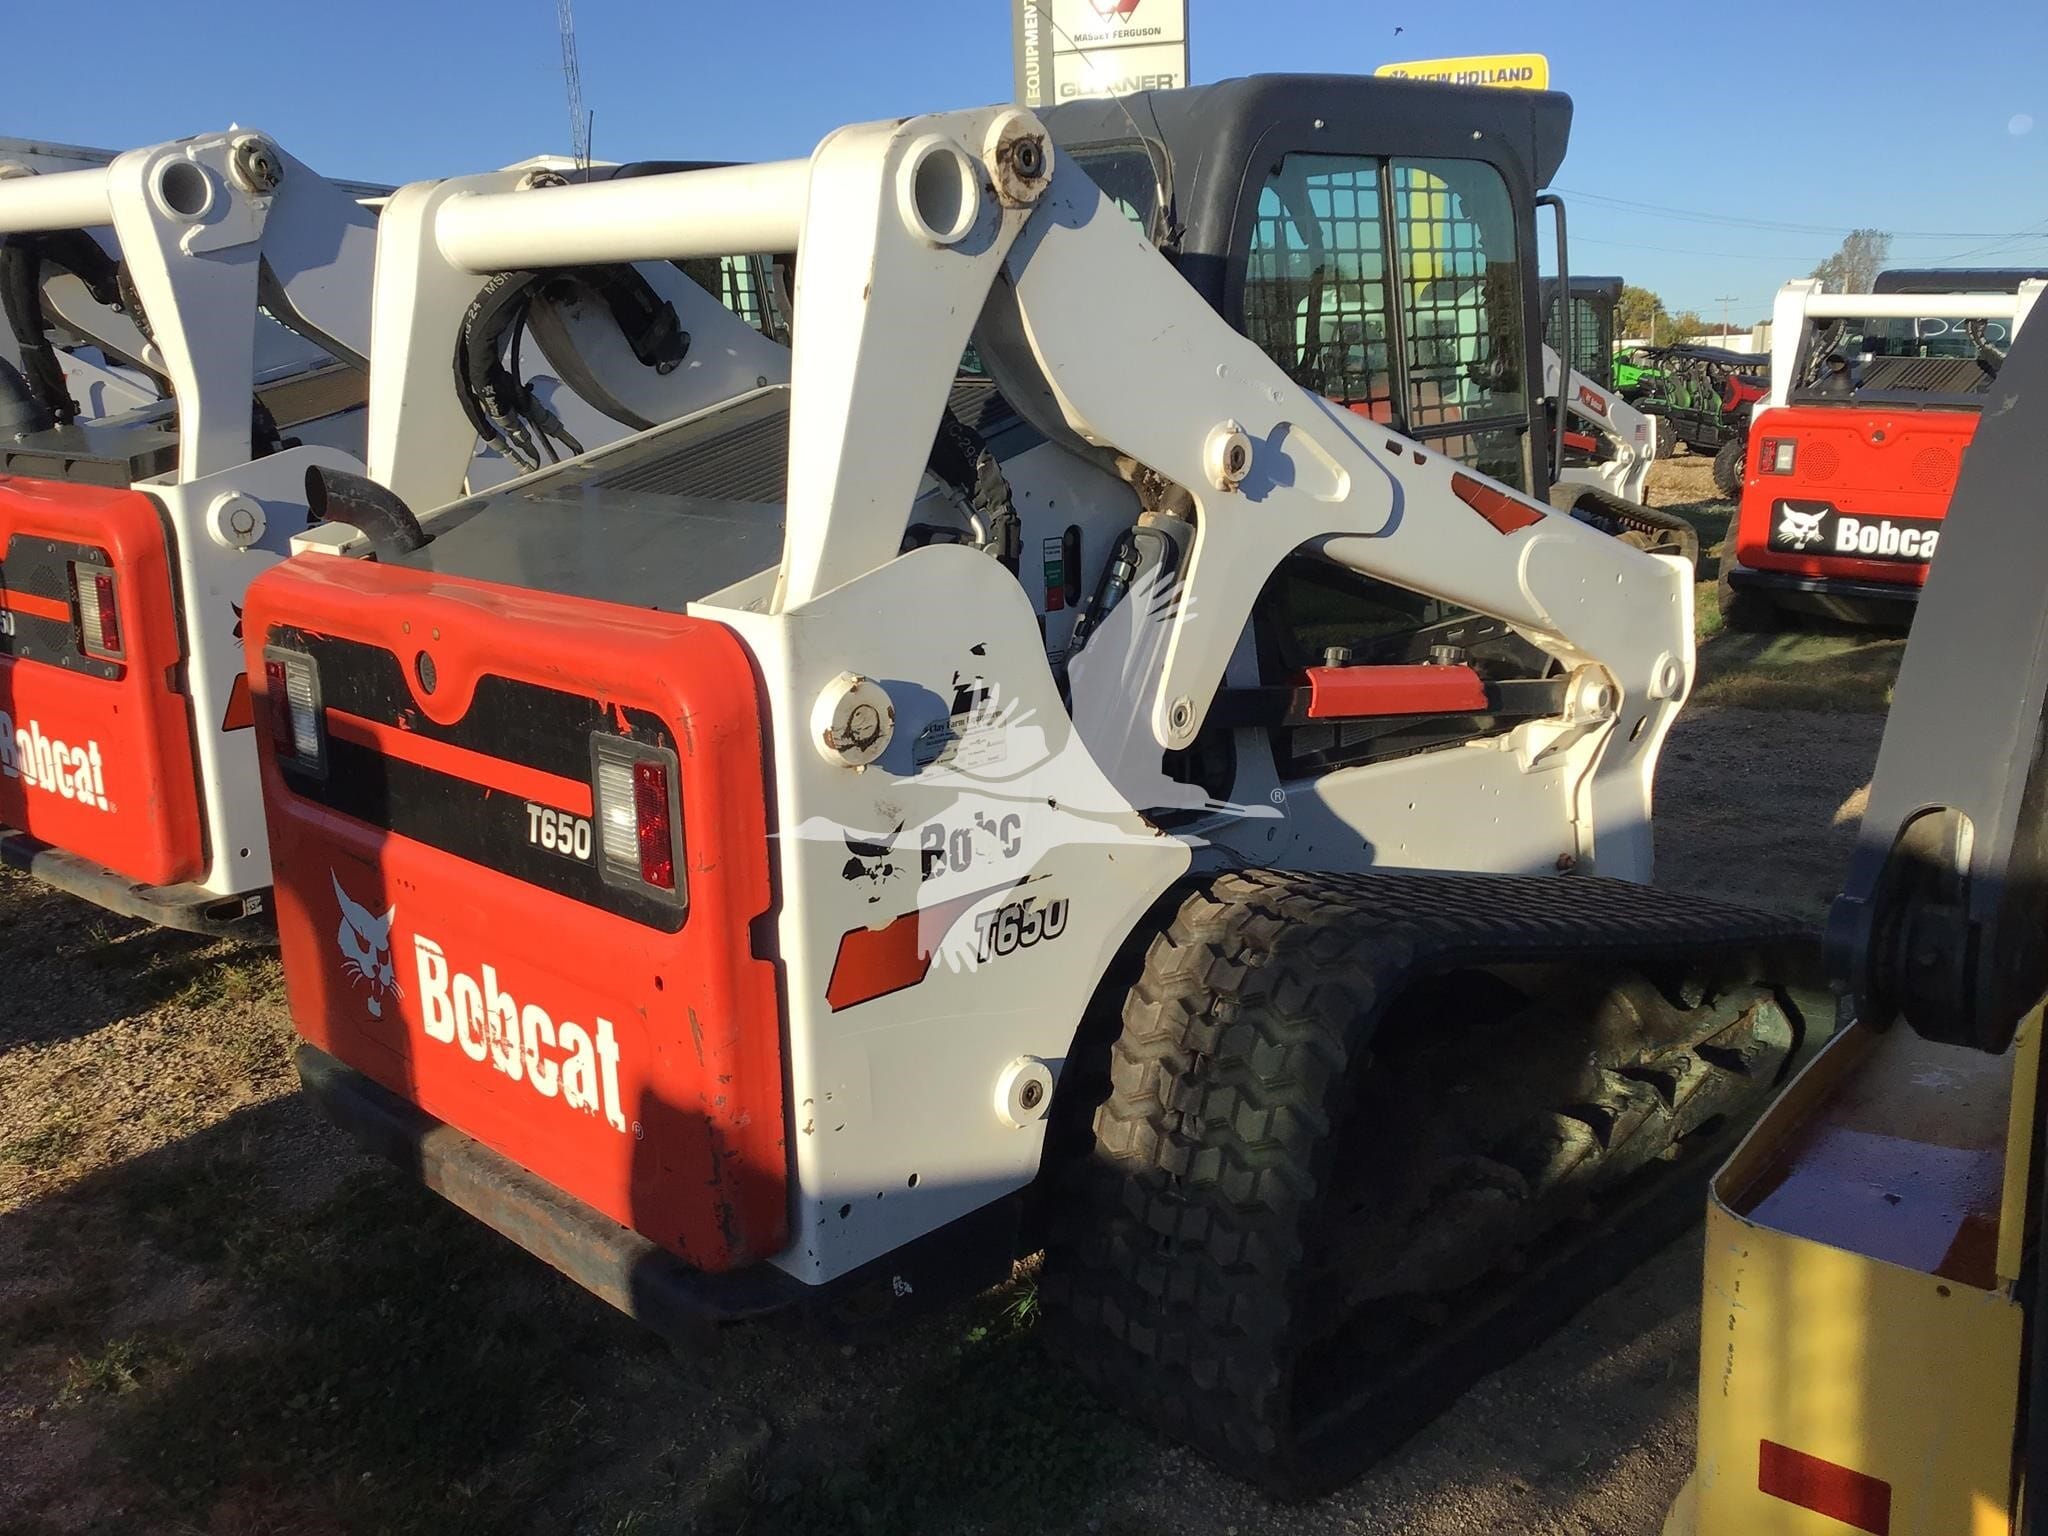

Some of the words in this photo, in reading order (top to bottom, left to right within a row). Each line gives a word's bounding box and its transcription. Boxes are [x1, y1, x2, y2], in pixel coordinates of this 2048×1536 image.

[1112, 27, 1162, 38] FERGUSON
[1456, 66, 1533, 85] HOLLAND
[1835, 517, 1940, 558] Bobca
[0, 709, 109, 812] Bobcat
[526, 803, 591, 860] T650
[974, 896, 1069, 964] T650
[413, 933, 626, 1133] Bobcat
